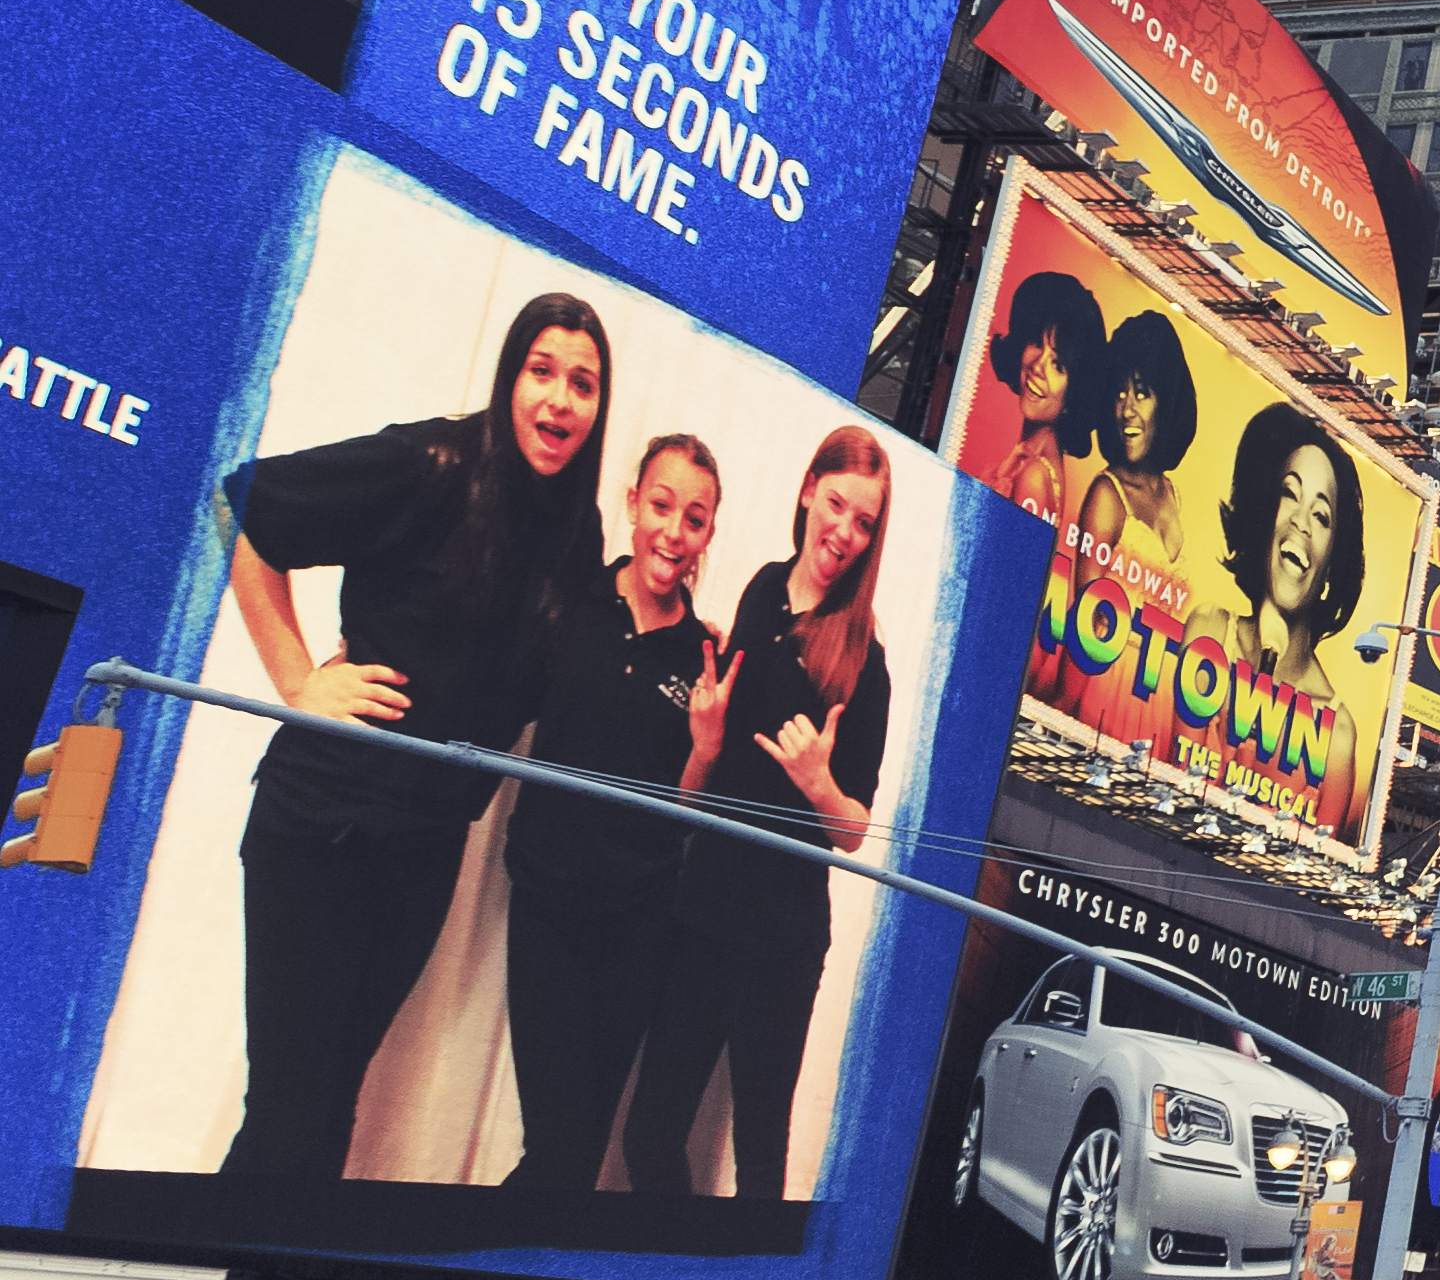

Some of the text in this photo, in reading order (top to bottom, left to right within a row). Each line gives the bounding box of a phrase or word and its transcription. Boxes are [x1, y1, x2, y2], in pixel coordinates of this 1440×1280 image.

[437, 23, 527, 115] OF
[558, 10, 810, 222] SECONDS
[1225, 93, 1280, 158] FROM
[1208, 158, 1275, 224] CHRYSLER
[0, 338, 151, 447] ATTLE
[1066, 524, 1188, 610] BROADWAY
[1018, 870, 1299, 991] CHRYSLER 300 MOTOWN
[1368, 977, 1385, 997] 46
[1392, 975, 1404, 987] ST
